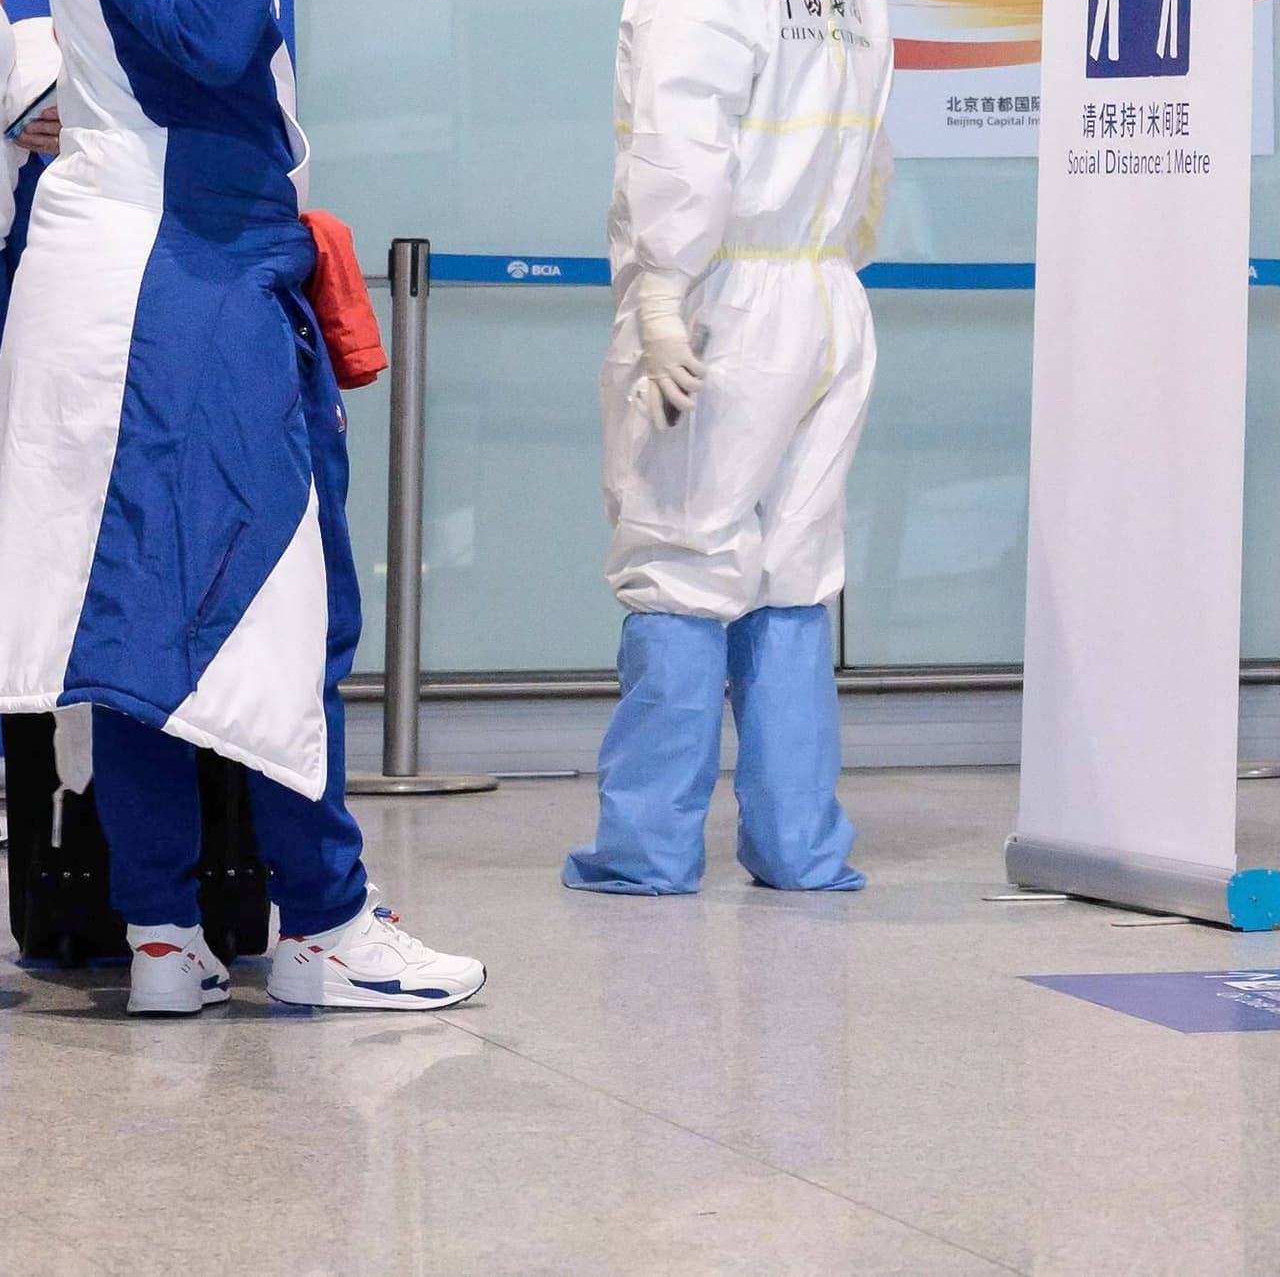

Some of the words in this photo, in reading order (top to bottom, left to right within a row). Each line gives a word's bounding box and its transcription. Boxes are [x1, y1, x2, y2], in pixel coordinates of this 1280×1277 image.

[781, 27, 824, 40] CHINA
[946, 116, 983, 128] Beijing
[986, 116, 1024, 128] Capital
[1082, 102, 1189, 138] 请保持1米间距
[1068, 149, 1100, 174] Social
[532, 265, 561, 276] BCIA
